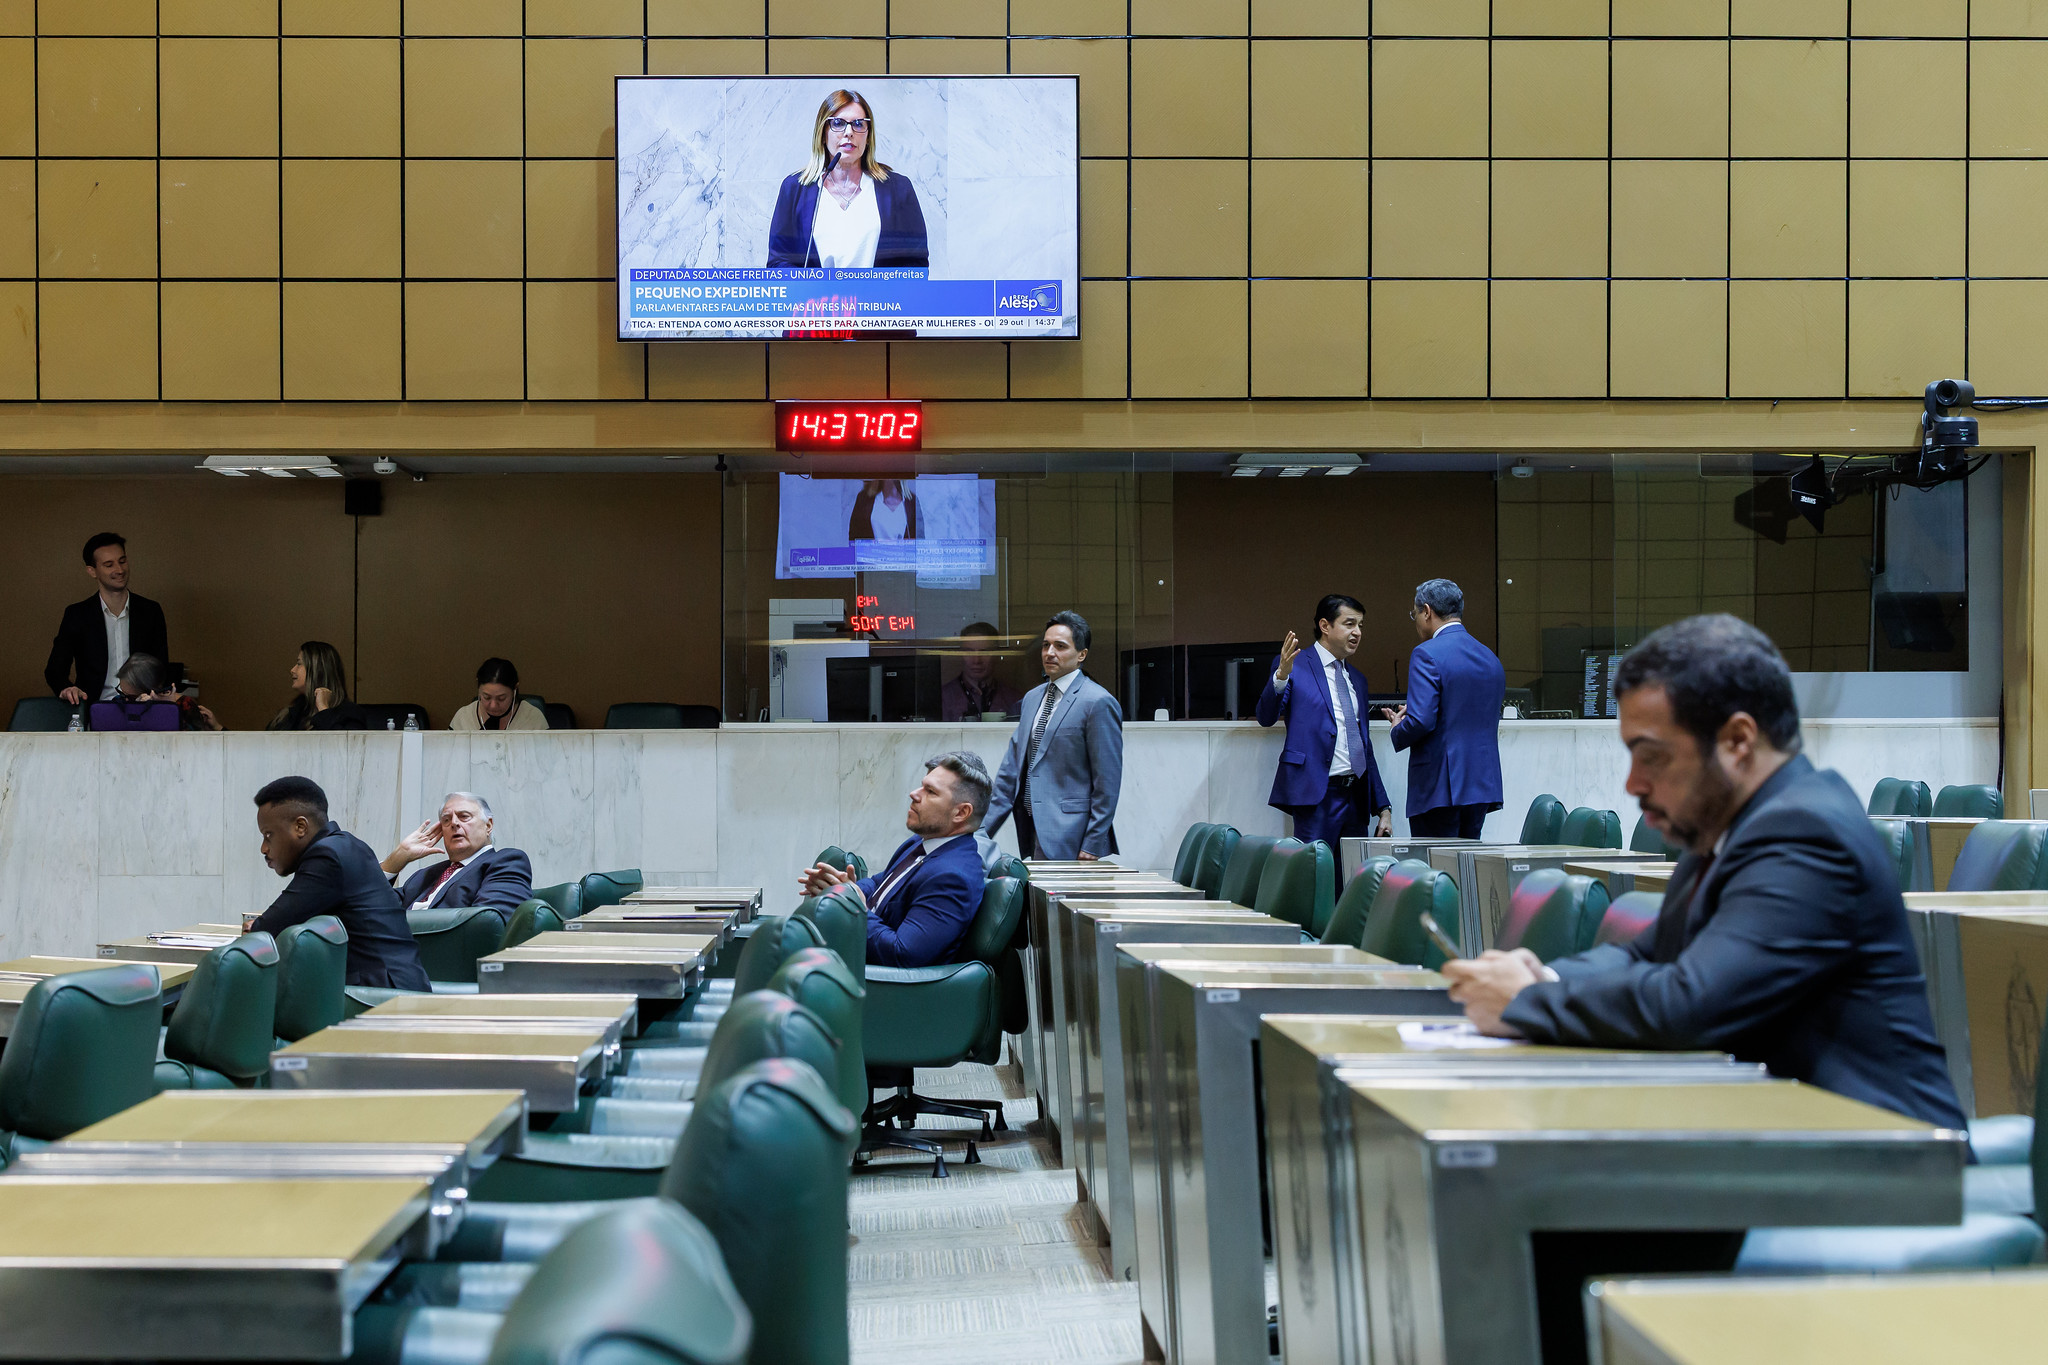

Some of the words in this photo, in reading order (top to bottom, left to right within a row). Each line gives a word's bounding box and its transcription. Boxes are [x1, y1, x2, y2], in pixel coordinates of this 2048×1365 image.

[635, 270, 691, 280] DEPUTADA
[692, 270, 741, 280] SOLANGE
[742, 270, 783, 280] FREITAS
[790, 268, 824, 279] UNIÃO
[835, 269, 924, 280] @sousolangefreitas
[635, 287, 702, 299] PEQUENO
[705, 286, 787, 298] EXPEDIENTE
[635, 303, 719, 312] PARLAMENTARES
[721, 303, 755, 312] FALAM
[757, 303, 770, 311] DE
[771, 303, 805, 311] TEMAS
[807, 303, 839, 311] LIVRES
[841, 303, 856, 311] NA
[858, 302, 901, 311] TRIBUNA
[999, 295, 1038, 311] Alesp
[630, 320, 656, 329] TICA:
[658, 320, 701, 329] ENTENDA
[703, 320, 732, 328] COMO
[734, 320, 785, 328] AGRESSOR
[788, 320, 806, 328] USA
[808, 320, 832, 328] PETS
[834, 320, 859, 328] PARA
[861, 320, 924, 328] CHANTAGEAR
[926, 319, 976, 327] MULHERES
[1035, 318, 1056, 326] 14:37
[790, 412, 918, 440] 14:37:02
